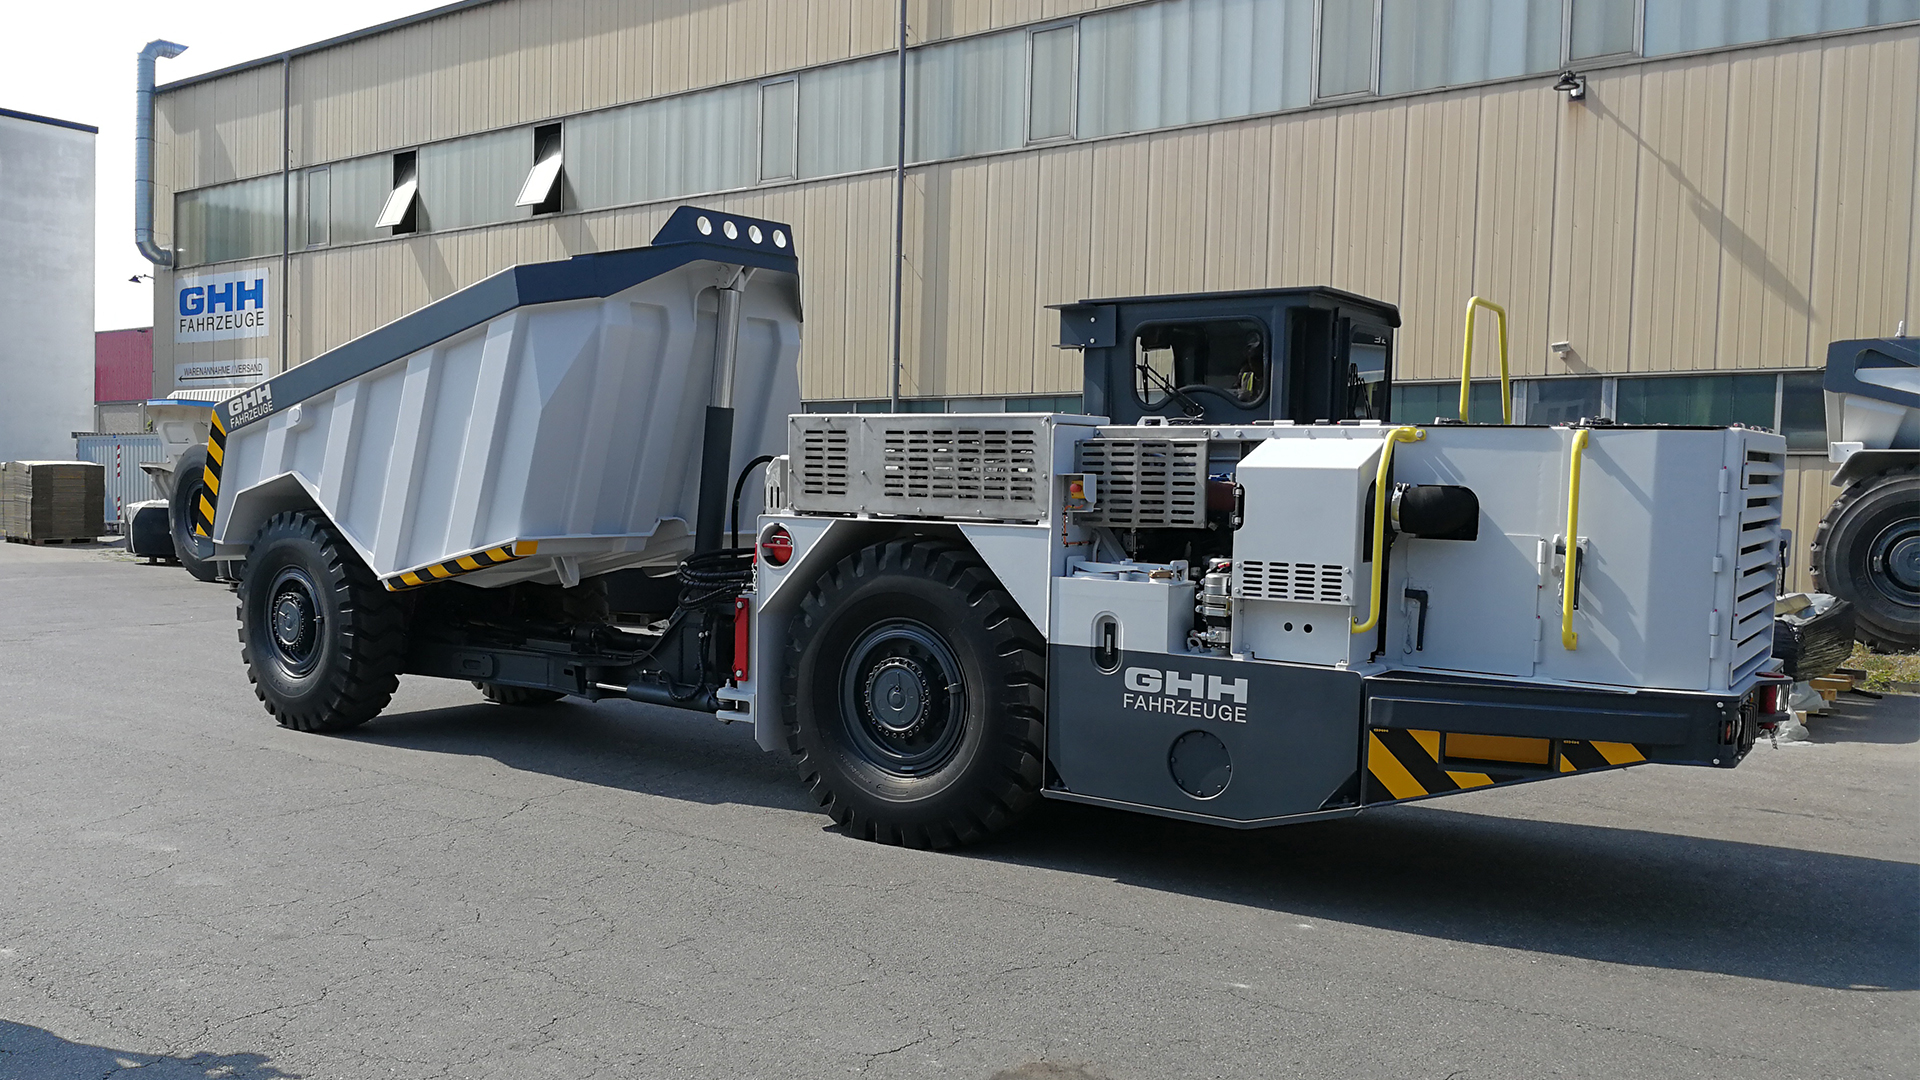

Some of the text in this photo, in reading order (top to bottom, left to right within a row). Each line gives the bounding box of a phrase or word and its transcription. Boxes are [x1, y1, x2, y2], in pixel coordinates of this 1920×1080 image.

[180, 278, 263, 316] GHH
[179, 311, 264, 333] FAHRZEUGE
[184, 365, 230, 376] WARENANNAHME
[236, 363, 263, 374] VERSAND
[228, 383, 272, 416] GHH
[230, 400, 273, 428] FAHRZEUGE
[1124, 666, 1248, 704] GHH
[1123, 693, 1247, 723] FAHRZEUGE
